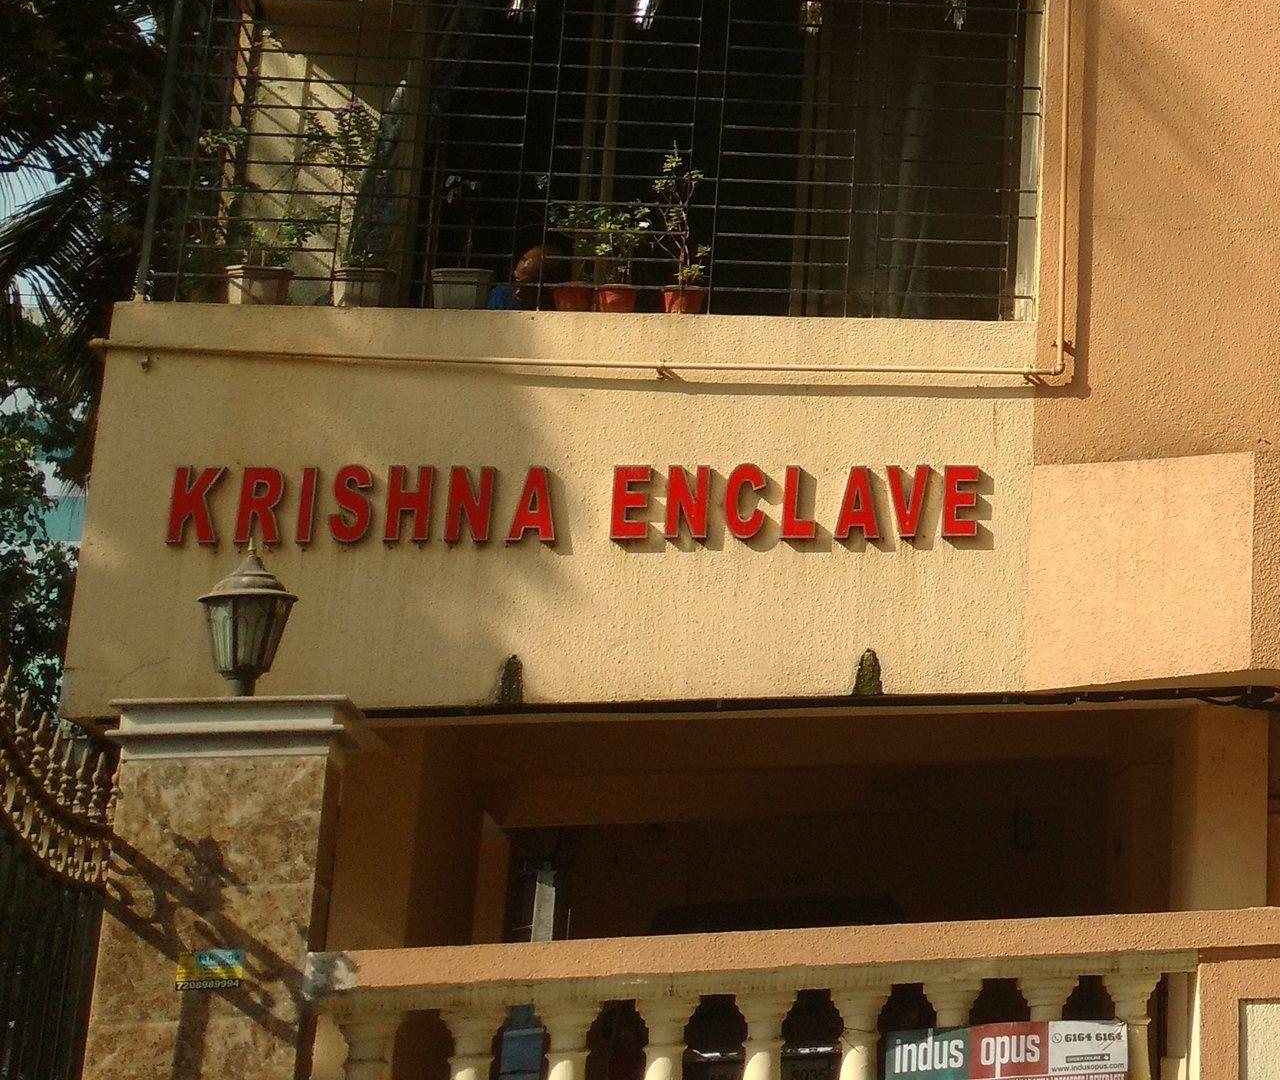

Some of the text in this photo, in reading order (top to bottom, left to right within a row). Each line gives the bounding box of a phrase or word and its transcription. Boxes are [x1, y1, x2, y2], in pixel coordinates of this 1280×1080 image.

[166, 462, 983, 546] KRISHNA ENCLAVE
[894, 1027, 1041, 1078] indus opus
[1064, 1031, 1123, 1043] 6164 6164
[1051, 1062, 1125, 1073] www.indusopus.com
